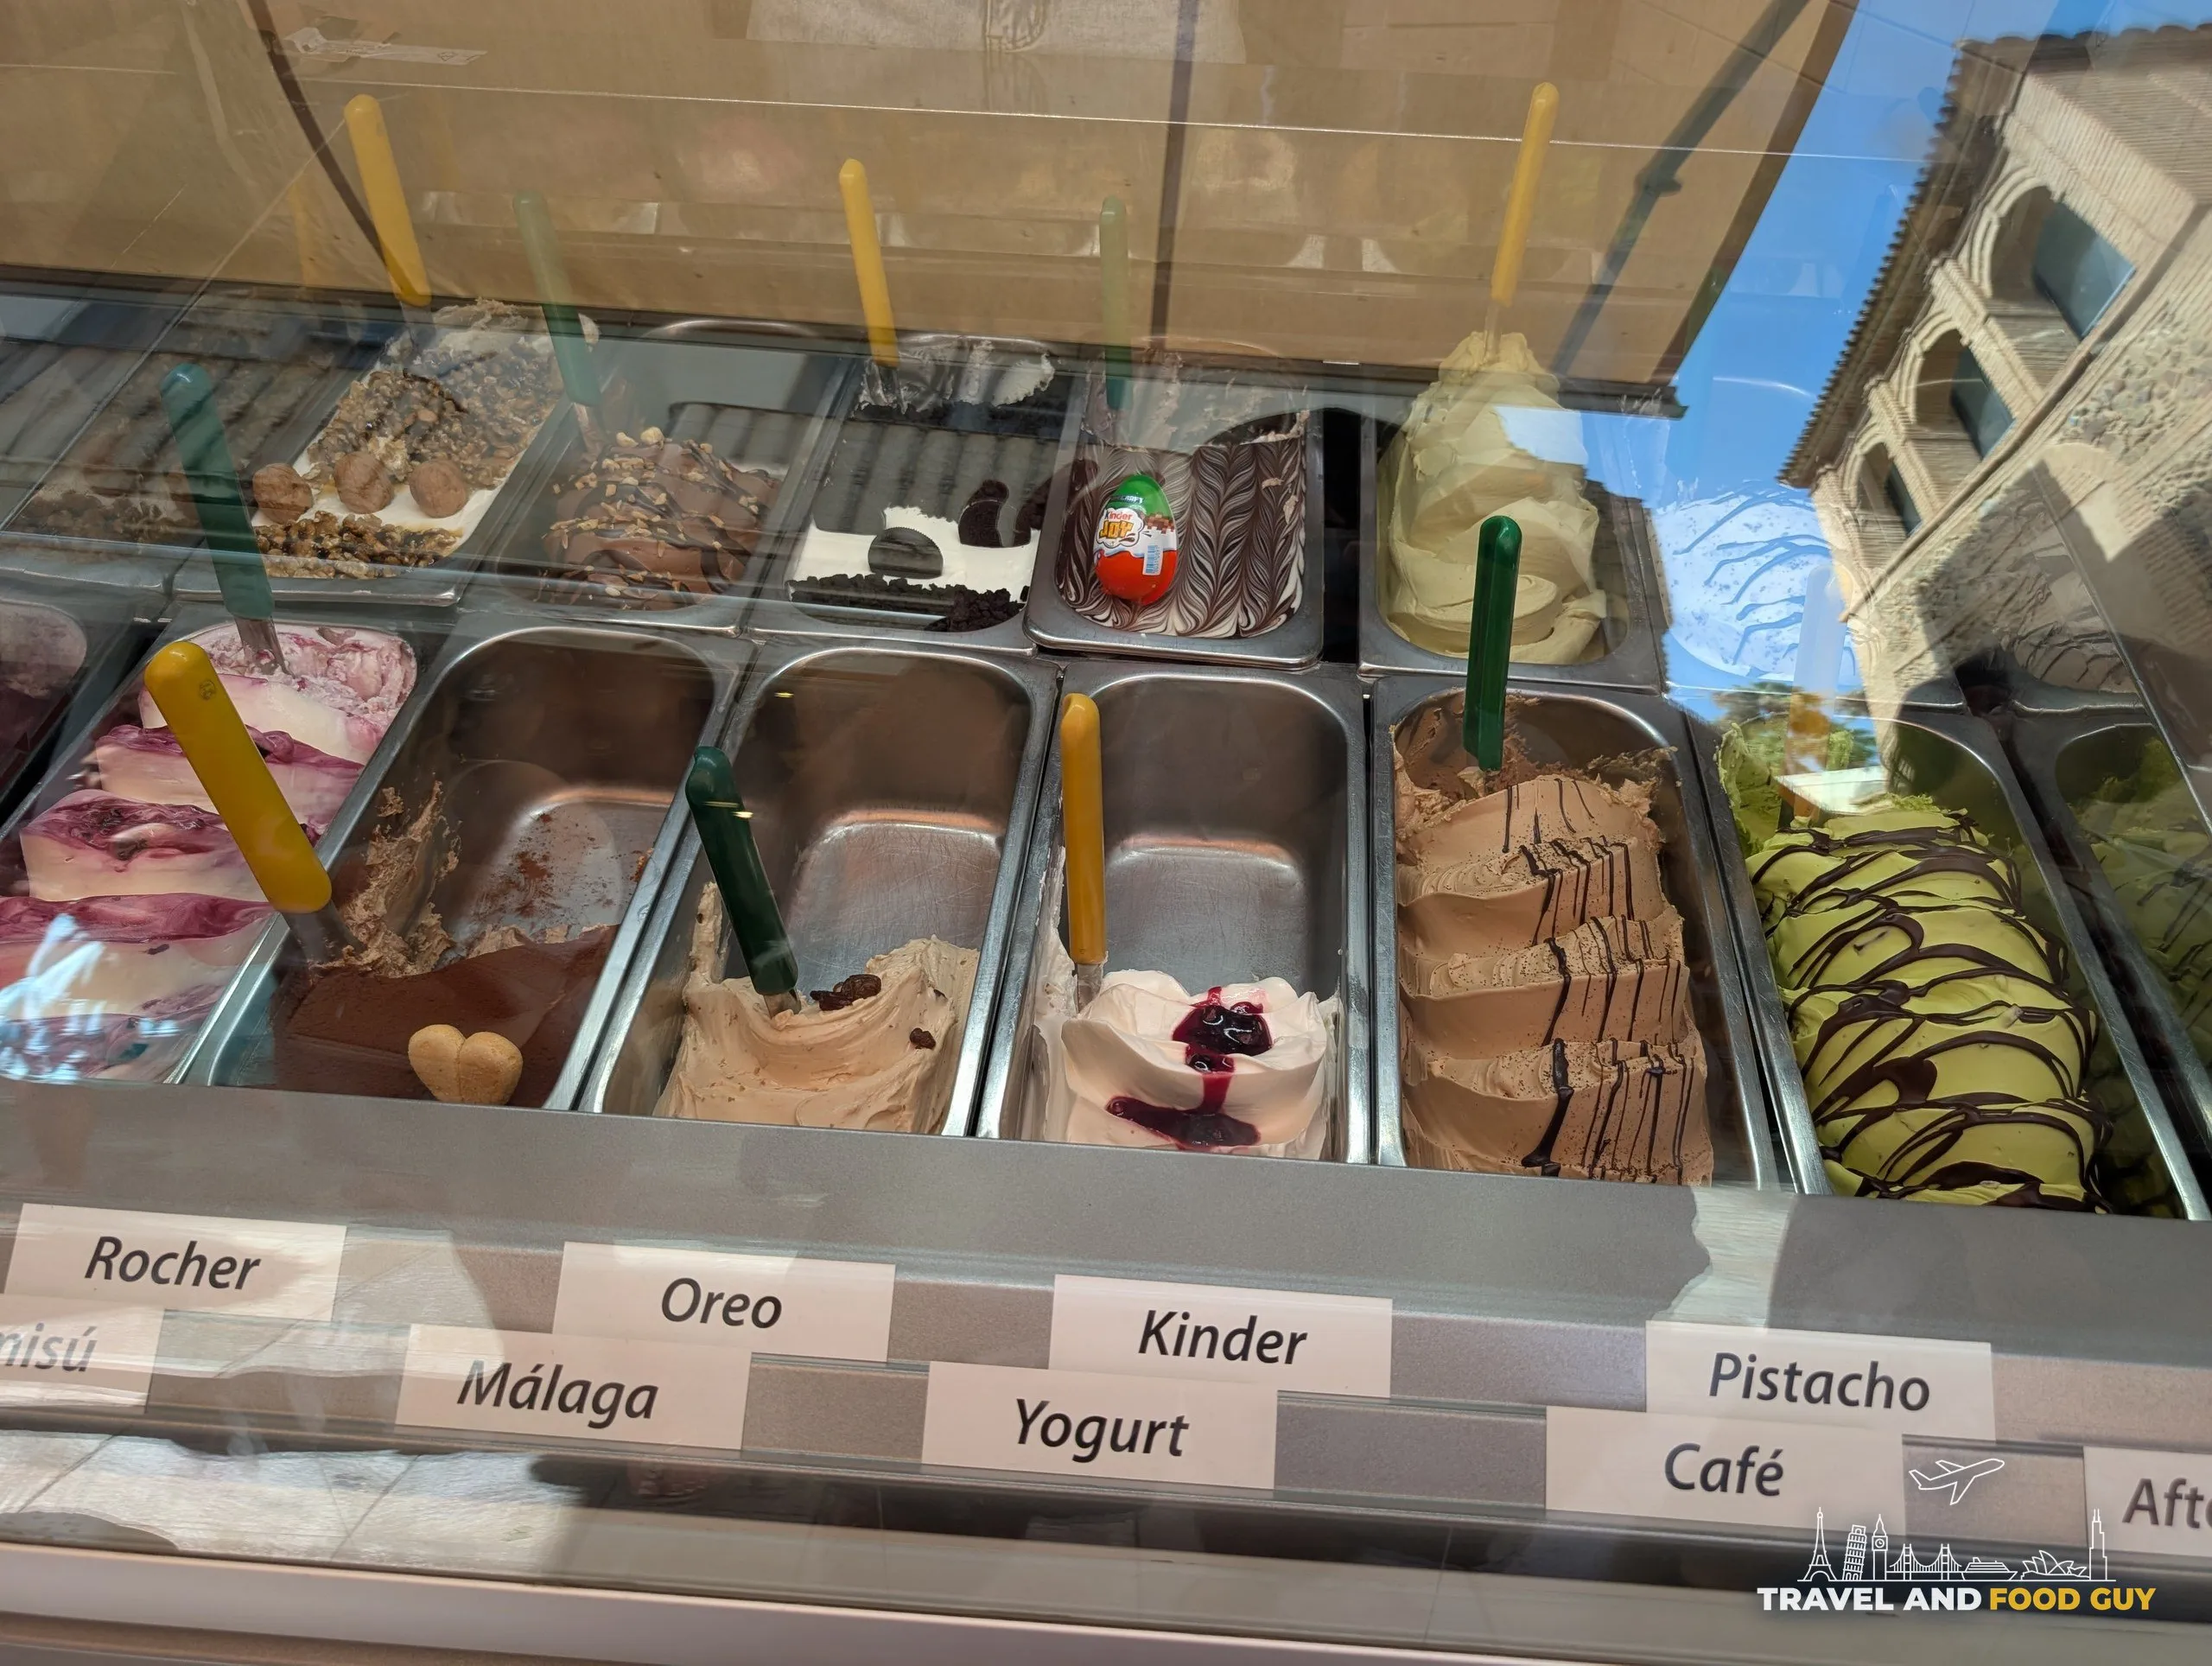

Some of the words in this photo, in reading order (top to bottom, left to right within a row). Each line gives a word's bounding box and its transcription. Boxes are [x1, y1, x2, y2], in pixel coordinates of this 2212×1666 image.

[1100, 521, 1135, 539] JOY
[85, 1236, 261, 1290] Rocher
[662, 1277, 782, 1329] Oreo
[1138, 1309, 1308, 1365] Kinder
[456, 1361, 658, 1429] Málaga
[1709, 1352, 1930, 1412] Pistacho
[1016, 1398, 1190, 1464] Yogurt
[1664, 1443, 1784, 1497] Café
